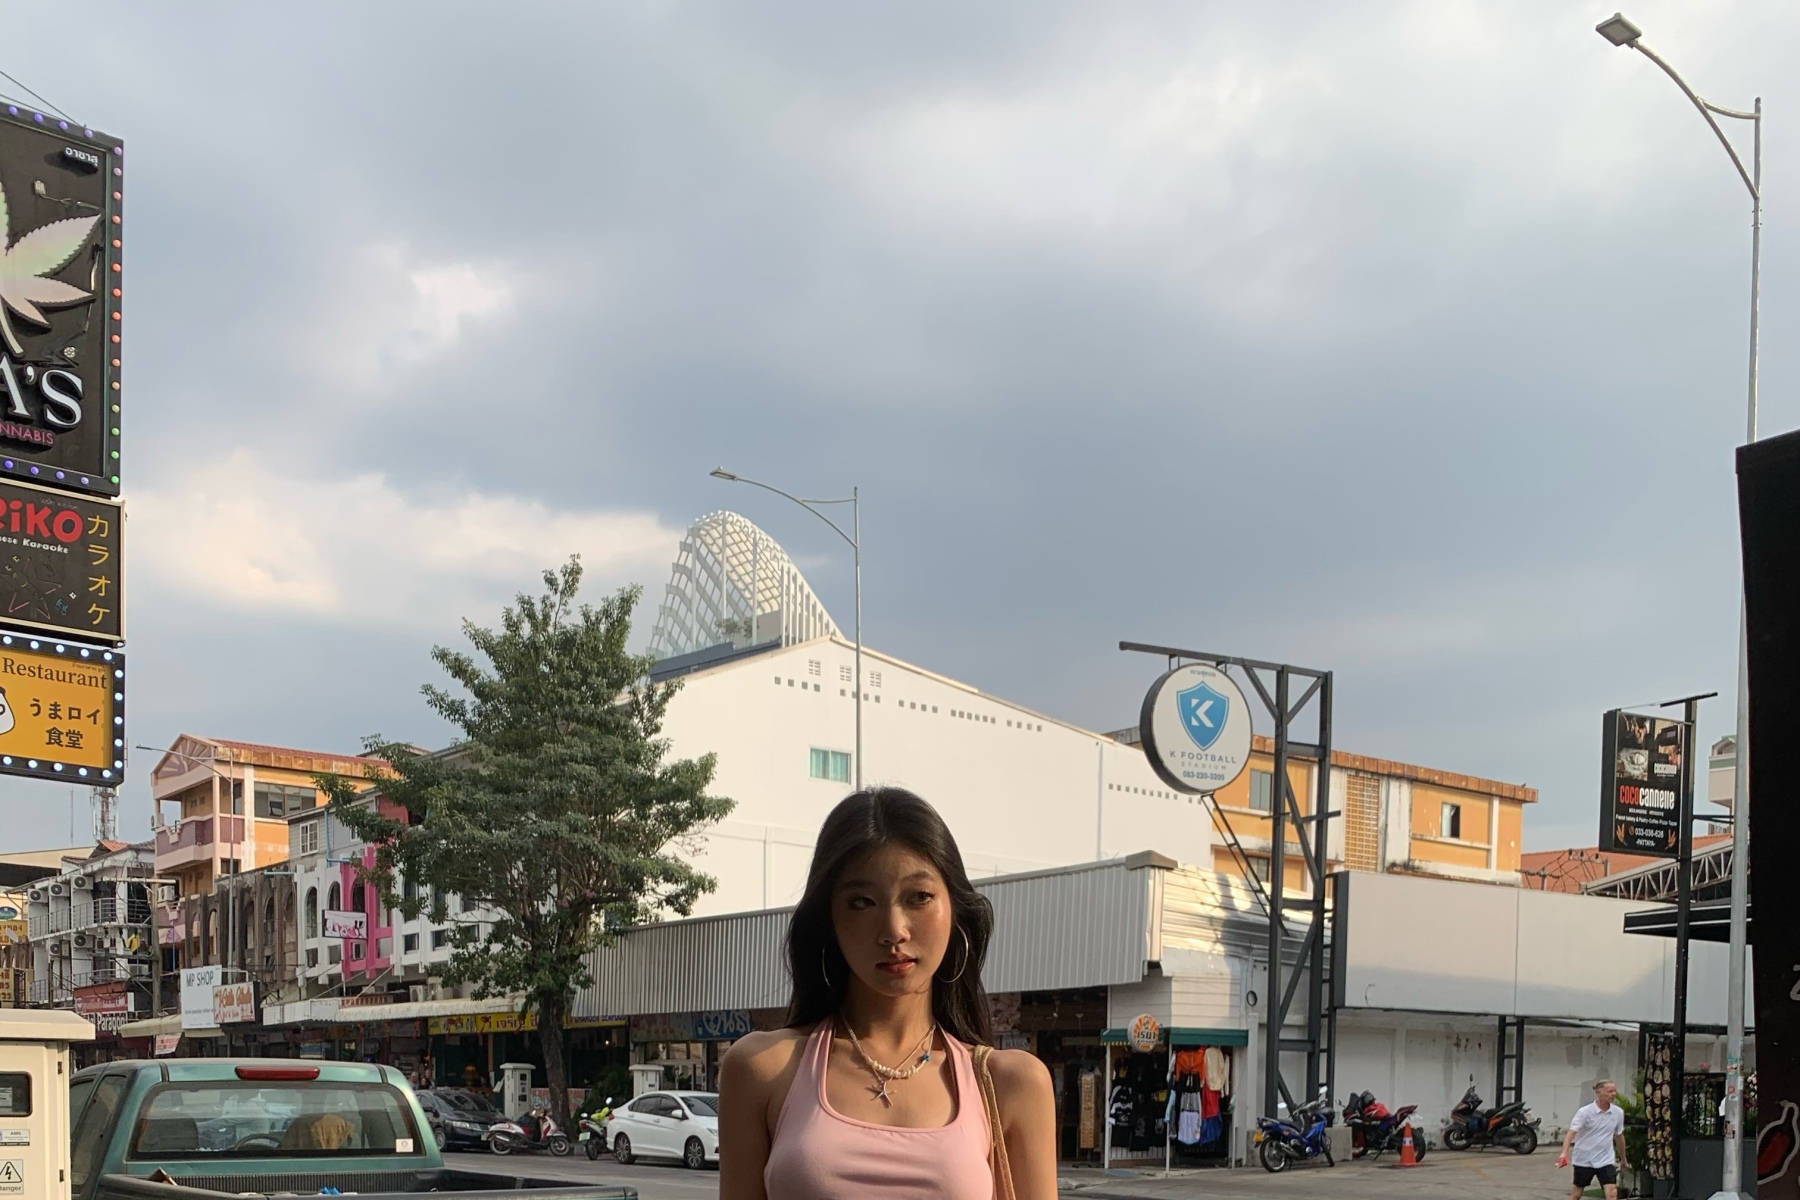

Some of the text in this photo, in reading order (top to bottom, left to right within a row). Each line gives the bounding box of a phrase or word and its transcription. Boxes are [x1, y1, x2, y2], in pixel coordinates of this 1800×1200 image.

[22, 537, 69, 554] Karaoke
[87, 514, 112, 625] カラオケ
[2, 657, 107, 690] Restaurant
[29, 697, 101, 725] うまロイ
[45, 726, 84, 750] 食堂
[1169, 750, 1237, 764] K FOOTBALL
[196, 970, 215, 987] SHOP
